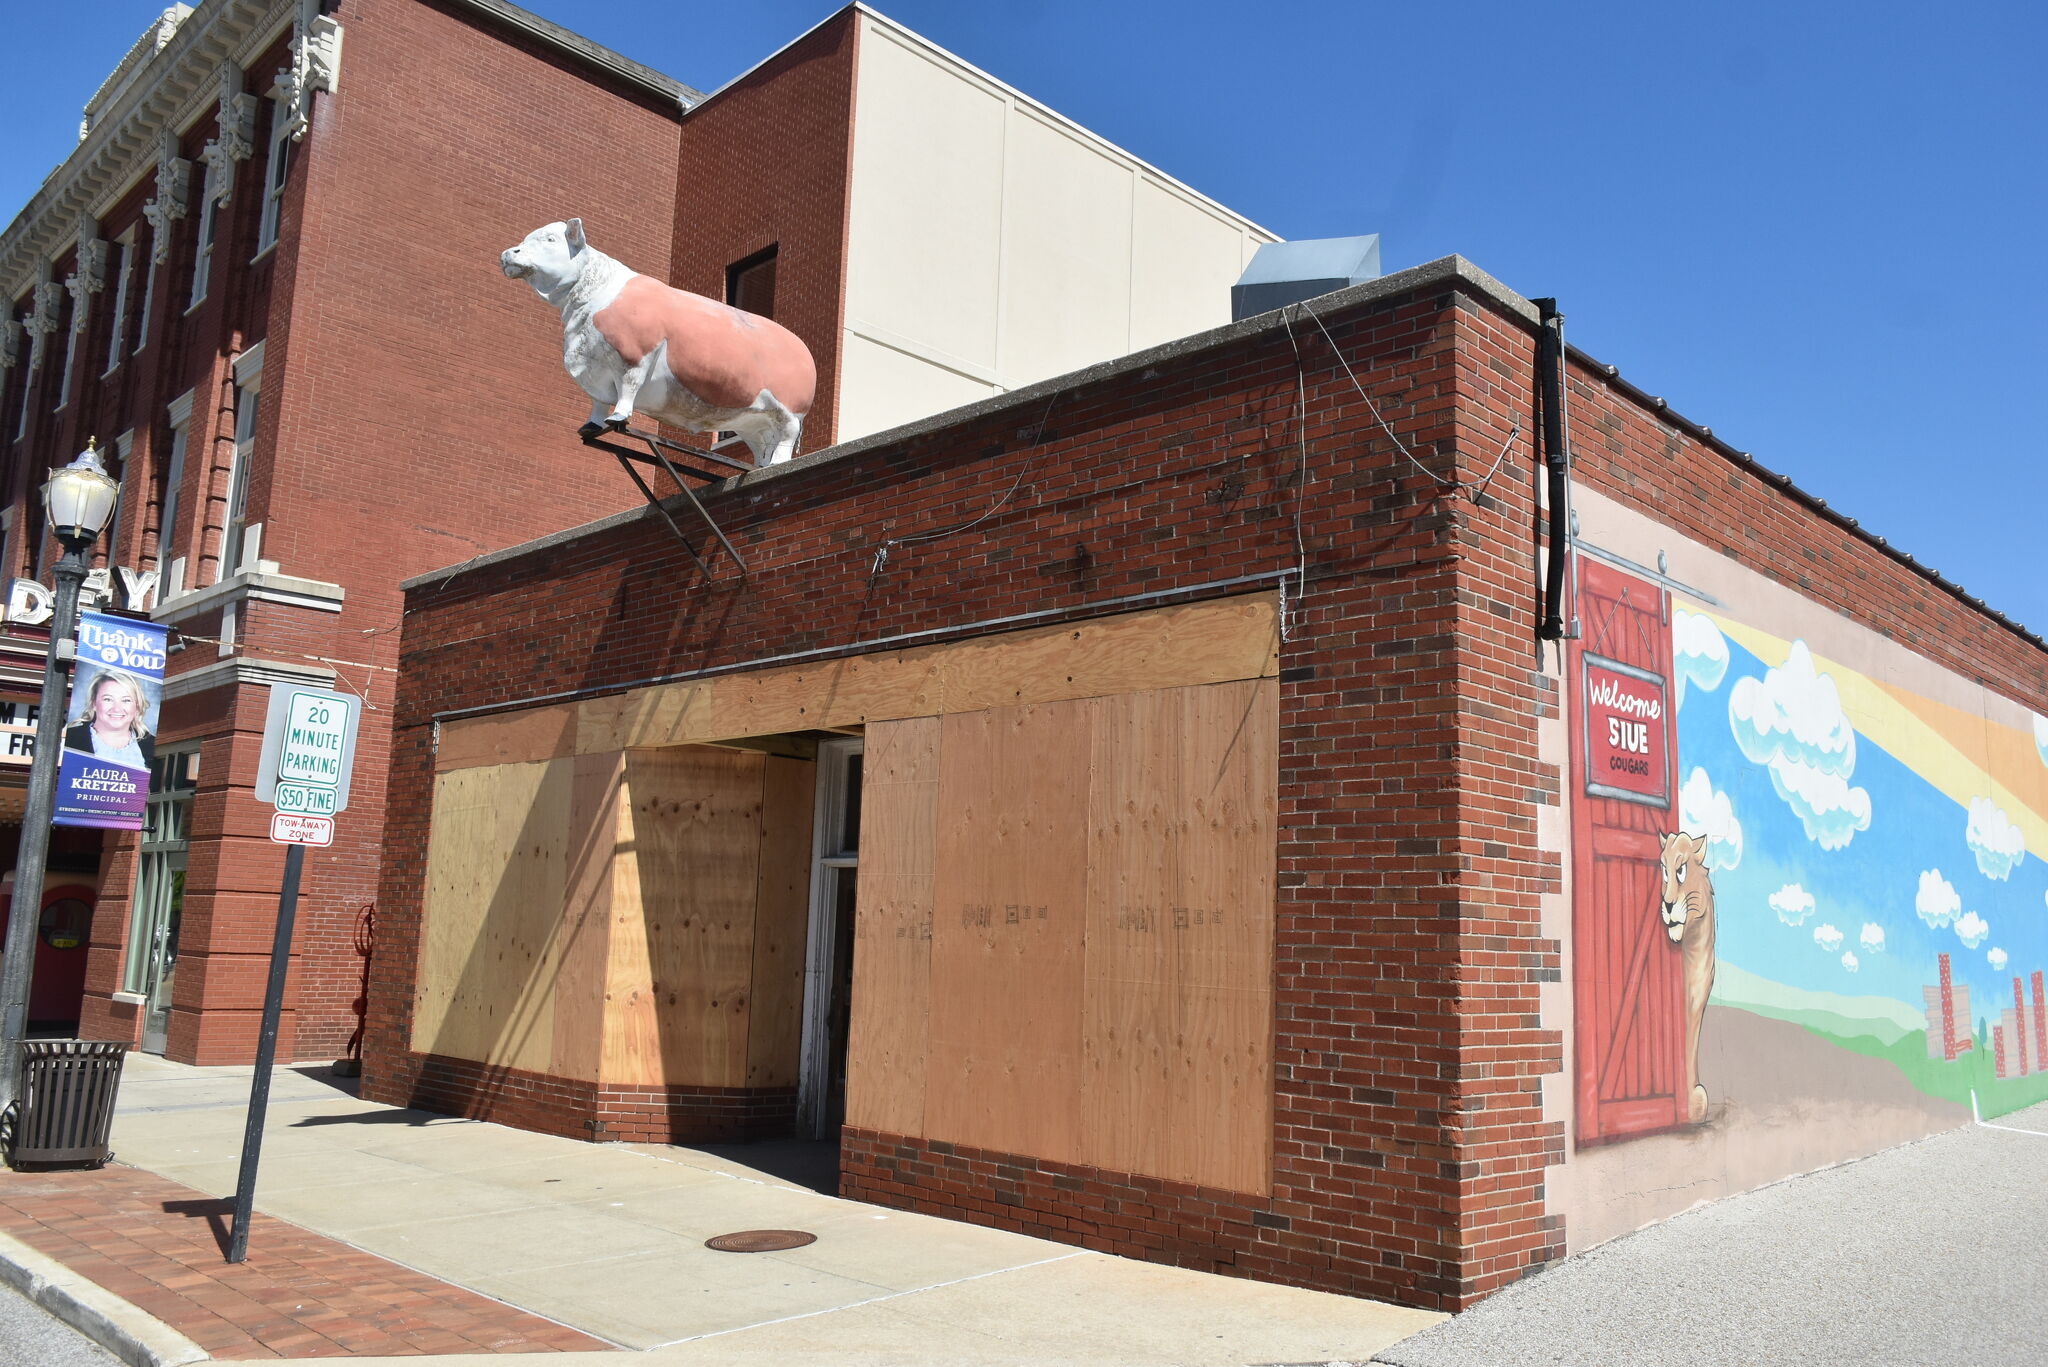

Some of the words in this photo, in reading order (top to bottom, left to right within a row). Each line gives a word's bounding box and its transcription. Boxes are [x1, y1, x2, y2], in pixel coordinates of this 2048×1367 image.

[79, 623, 153, 652] Thank
[118, 647, 166, 670] You
[1589, 677, 1661, 720] Welcome
[308, 707, 329, 724] 20
[291, 728, 339, 750] MINUTE
[1607, 716, 1649, 754] SIUE
[82, 767, 129, 782] LAURA
[286, 752, 337, 775] PARKING
[1610, 755, 1649, 777] COUGARS
[71, 778, 137, 794] KRETZER
[76, 793, 128, 804] PRINCIPAL
[280, 788, 303, 807] $50
[306, 791, 333, 810] FINE
[280, 819, 326, 830] TOW-AWAY
[288, 829, 315, 840] ZONE
